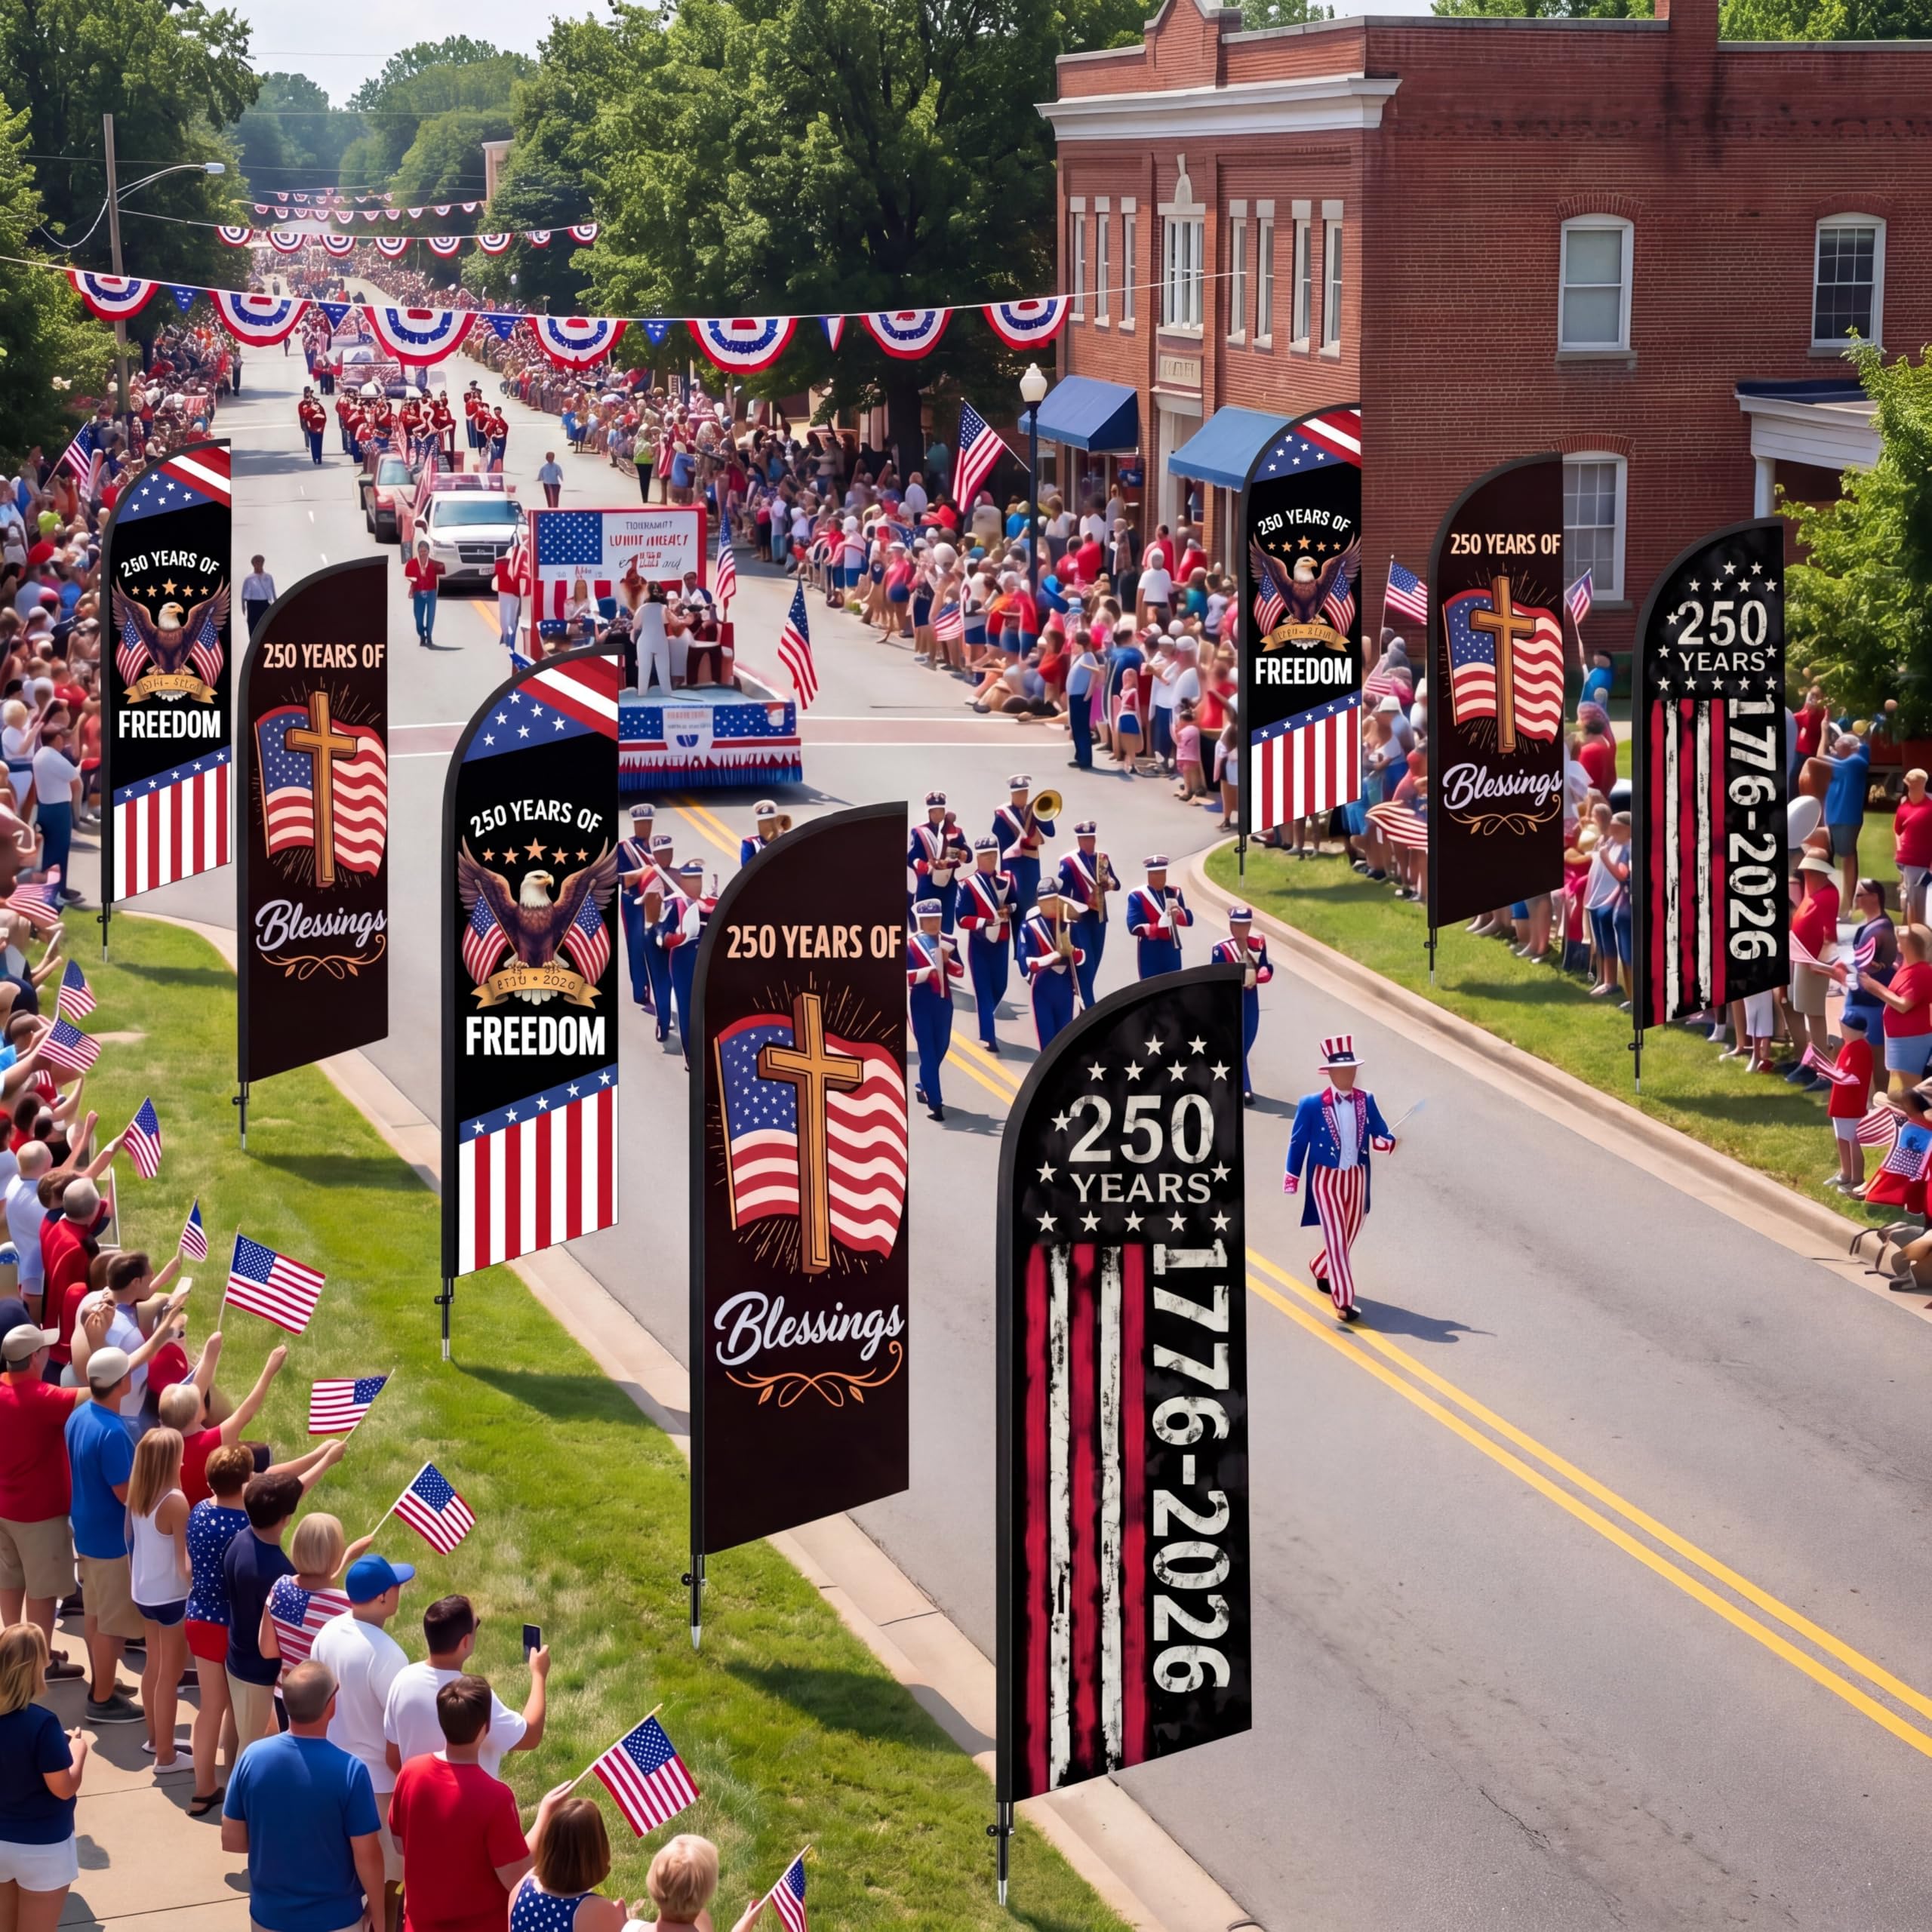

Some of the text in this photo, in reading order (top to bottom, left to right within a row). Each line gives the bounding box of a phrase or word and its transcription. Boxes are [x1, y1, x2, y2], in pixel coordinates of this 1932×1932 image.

[1257, 509, 1352, 536] 250 YEARS OF
[1451, 533, 1561, 555] 250 YEARS OF
[120, 549, 220, 577] 250 YEARS OF
[1676, 600, 1767, 646] 250
[263, 643, 385, 669] 250 YEARS OF
[1255, 657, 1352, 685] FREEDOM
[1678, 651, 1765, 672] YEARS
[118, 709, 221, 739] FREEDOM
[1442, 762, 1562, 811] Blessings
[469, 799, 603, 838] 250 YEARS OF
[1728, 694, 1777, 961] 1776-2026
[255, 899, 387, 952] Blessings
[727, 924, 902, 958] 250 YEARS OF
[466, 1015, 605, 1056] FREEDOM
[1068, 1094, 1214, 1164] 250
[1069, 1173, 1211, 1204] YEARS
[713, 1291, 905, 1366] Blessings
[1151, 1238, 1231, 1694] 1776-2026
